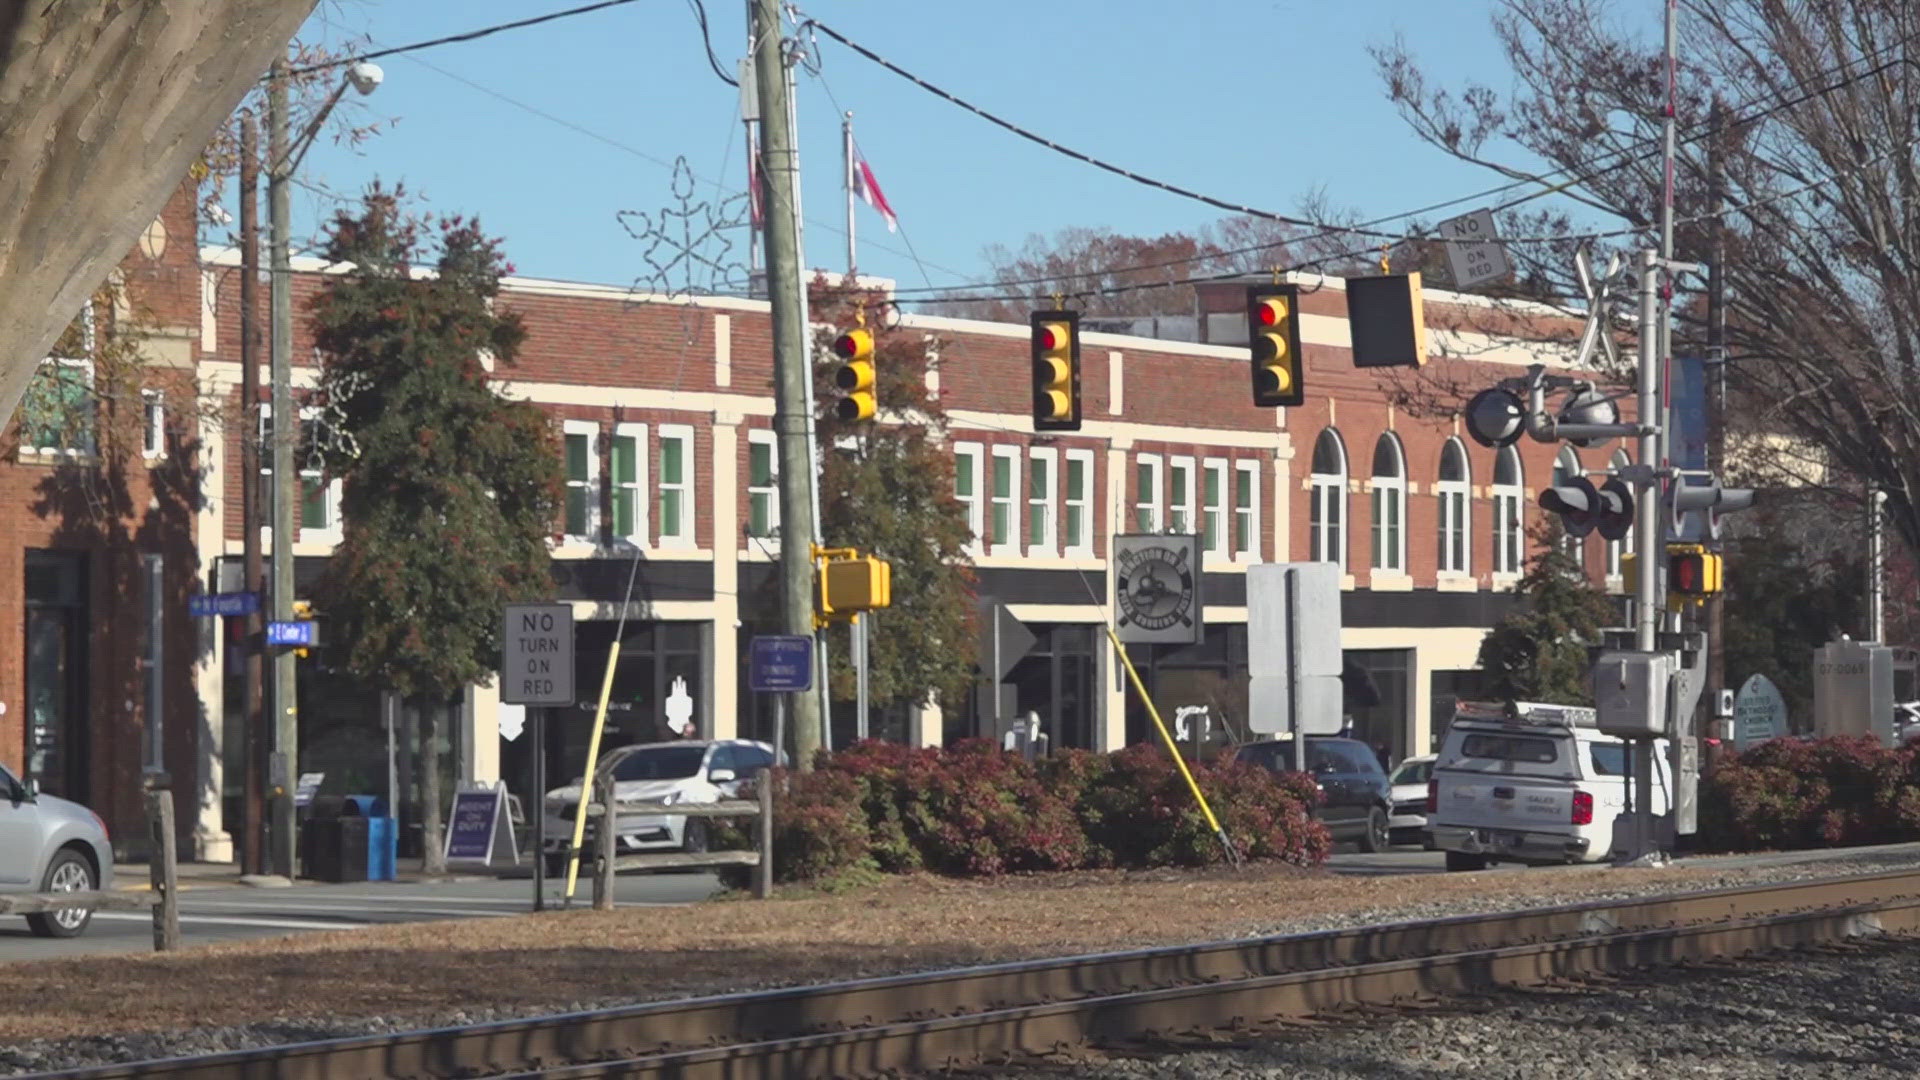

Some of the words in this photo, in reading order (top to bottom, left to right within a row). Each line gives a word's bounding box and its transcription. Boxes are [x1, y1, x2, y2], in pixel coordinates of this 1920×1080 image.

[1454, 219, 1479, 237] NO
[1467, 250, 1486, 264] ON
[1467, 262, 1492, 278] RED
[523, 613, 553, 632] NO
[518, 637, 559, 653] TURN
[756, 642, 805, 652] SHOPPING
[527, 658, 550, 674] ON
[761, 665, 797, 675] DINING
[523, 679, 553, 695] RED
[458, 821, 487, 832] DUTY
